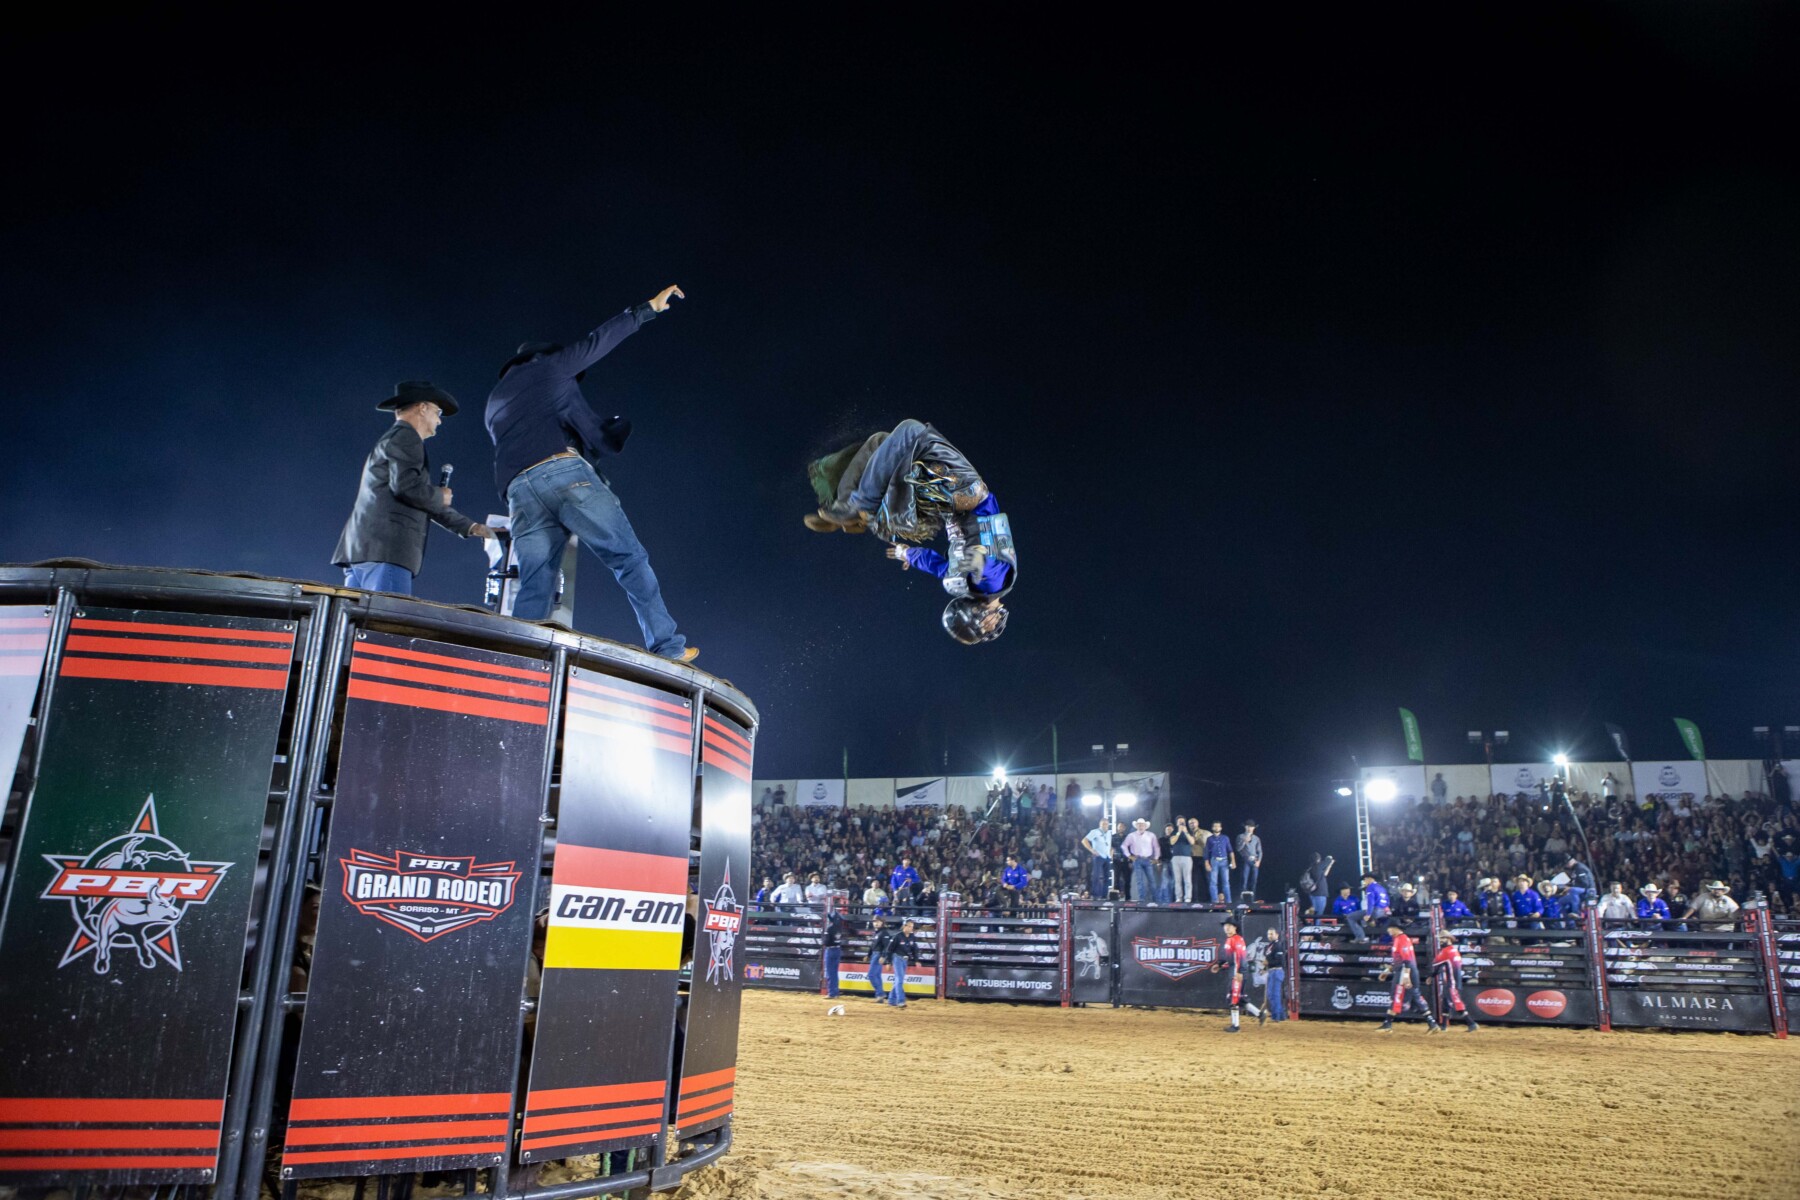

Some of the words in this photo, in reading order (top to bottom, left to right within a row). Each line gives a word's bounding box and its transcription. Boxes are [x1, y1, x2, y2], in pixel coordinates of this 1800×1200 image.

[408, 858, 461, 871] PBR
[59, 873, 207, 896] PBR
[357, 873, 431, 899] GRAND
[436, 877, 503, 907] RODEO
[399, 905, 439, 914] SORRISO
[556, 893, 685, 926] can-am
[707, 913, 740, 929] PBR
[1139, 947, 1175, 961] GRAND
[1177, 948, 1212, 962] RODEO
[764, 967, 800, 976] NAVARINI
[967, 979, 1015, 989] MITSUBISHI
[1016, 980, 1053, 990] MOTORS
[1356, 994, 1393, 1004] SORRIS
[1642, 995, 1734, 1010] ALMARA
